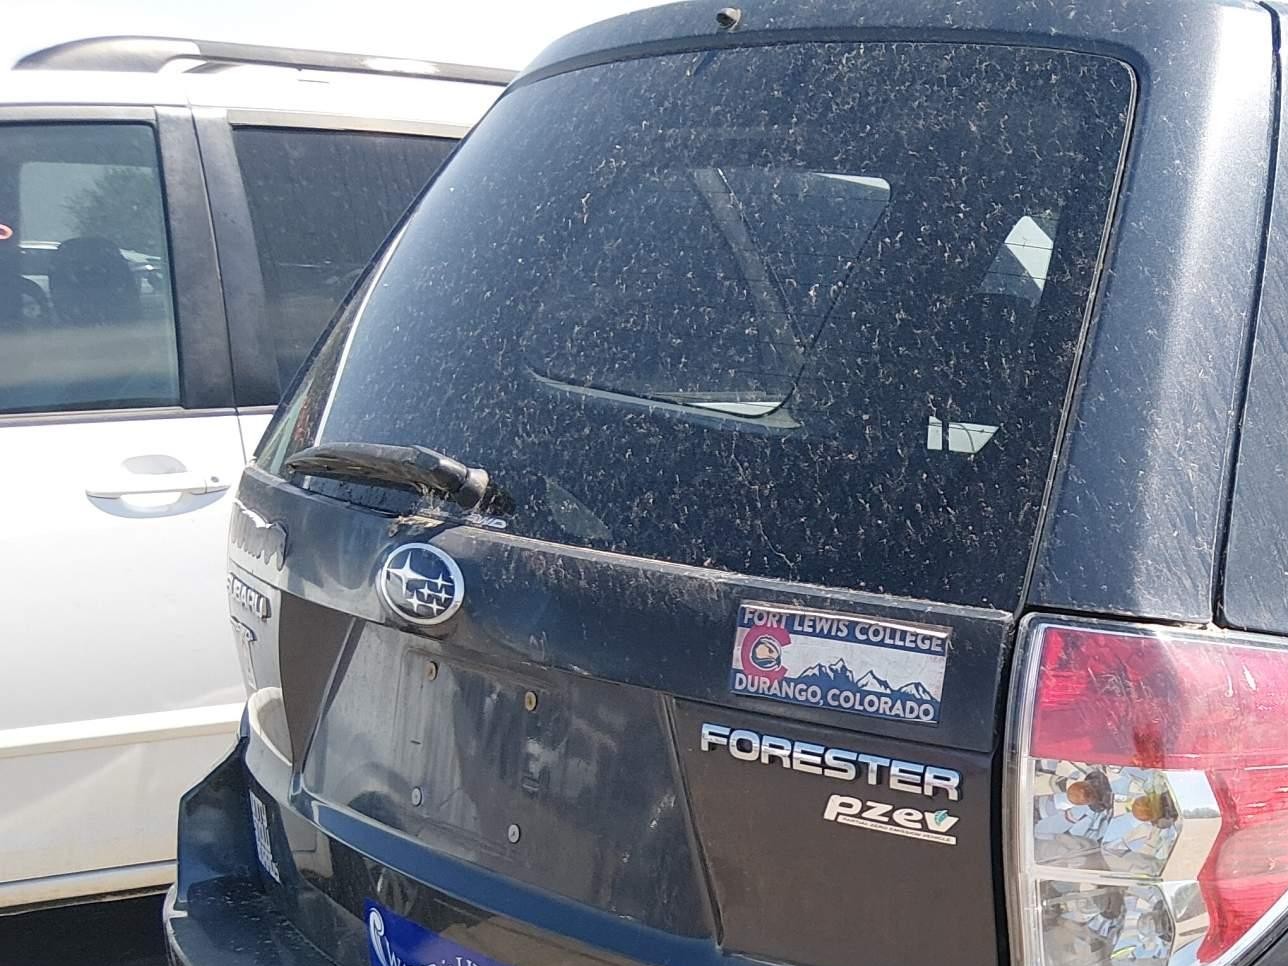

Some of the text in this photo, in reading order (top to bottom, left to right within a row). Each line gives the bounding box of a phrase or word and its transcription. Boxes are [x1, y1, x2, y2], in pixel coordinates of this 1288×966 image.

[744, 608, 944, 652] FORT LEWIS COLLEGE
[733, 672, 936, 720] DURANGO, COLORADO
[701, 722, 962, 802] FORESTER
